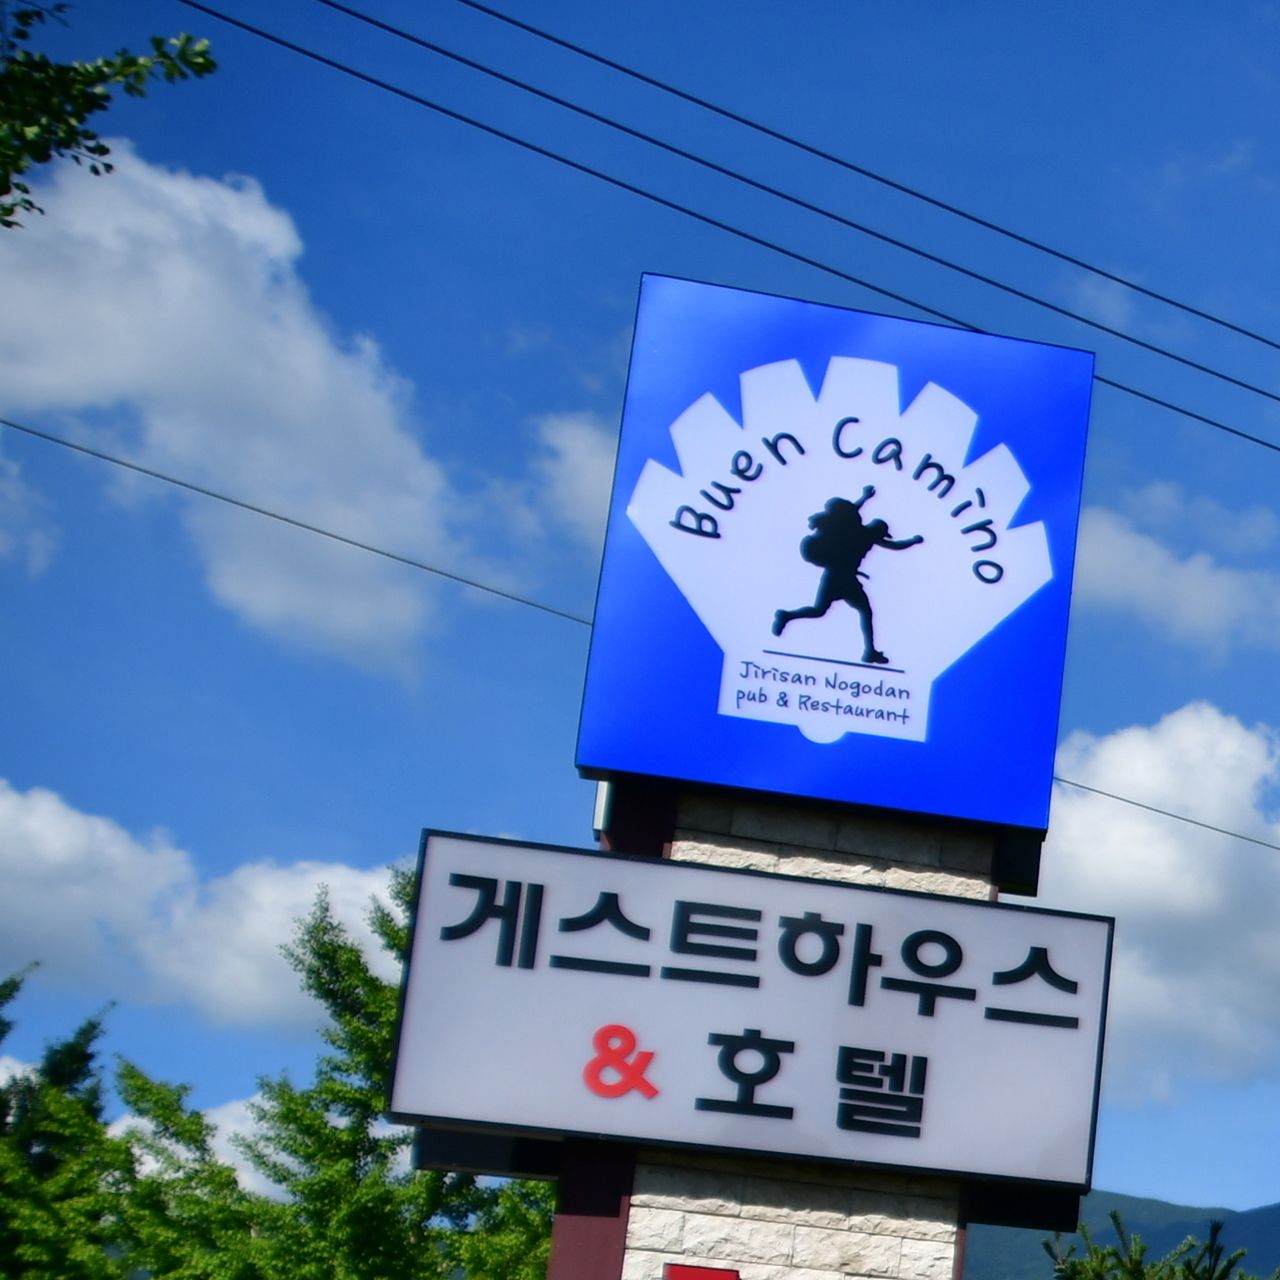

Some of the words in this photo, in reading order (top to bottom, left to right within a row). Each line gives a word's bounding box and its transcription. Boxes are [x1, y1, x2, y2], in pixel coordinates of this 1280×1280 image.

[669, 431, 806, 539] Buen
[831, 416, 1005, 586] Camino
[736, 686, 769, 710] pub
[776, 690, 789, 709] &
[798, 693, 911, 726] Restaurant
[739, 660, 817, 687] Jirisan
[824, 671, 911, 700] Nogodan
[439, 871, 1080, 1029] 게스트하우스
[582, 1023, 659, 1100] &
